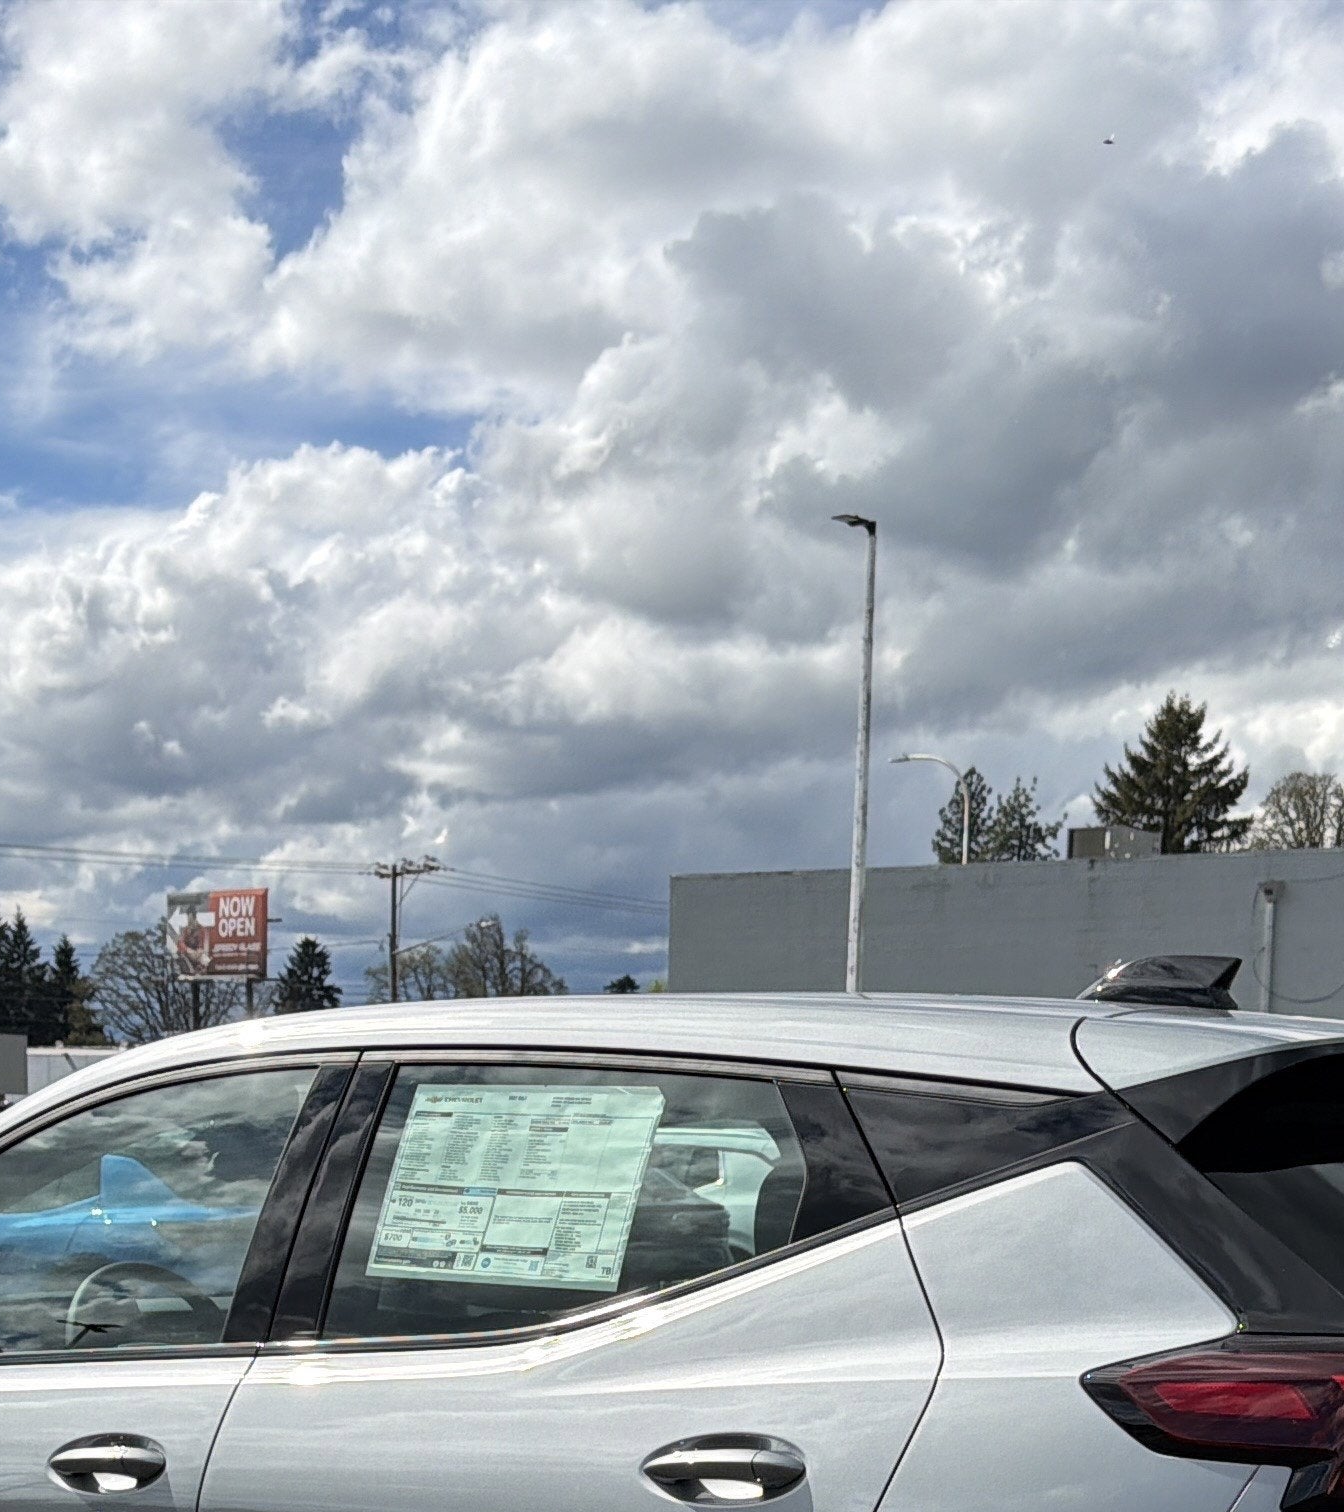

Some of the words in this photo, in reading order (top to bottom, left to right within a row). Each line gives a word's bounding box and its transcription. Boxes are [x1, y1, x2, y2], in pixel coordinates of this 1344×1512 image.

[218, 896, 256, 918] NOW
[218, 917, 256, 938] OPEN
[398, 1197, 414, 1208] 120
